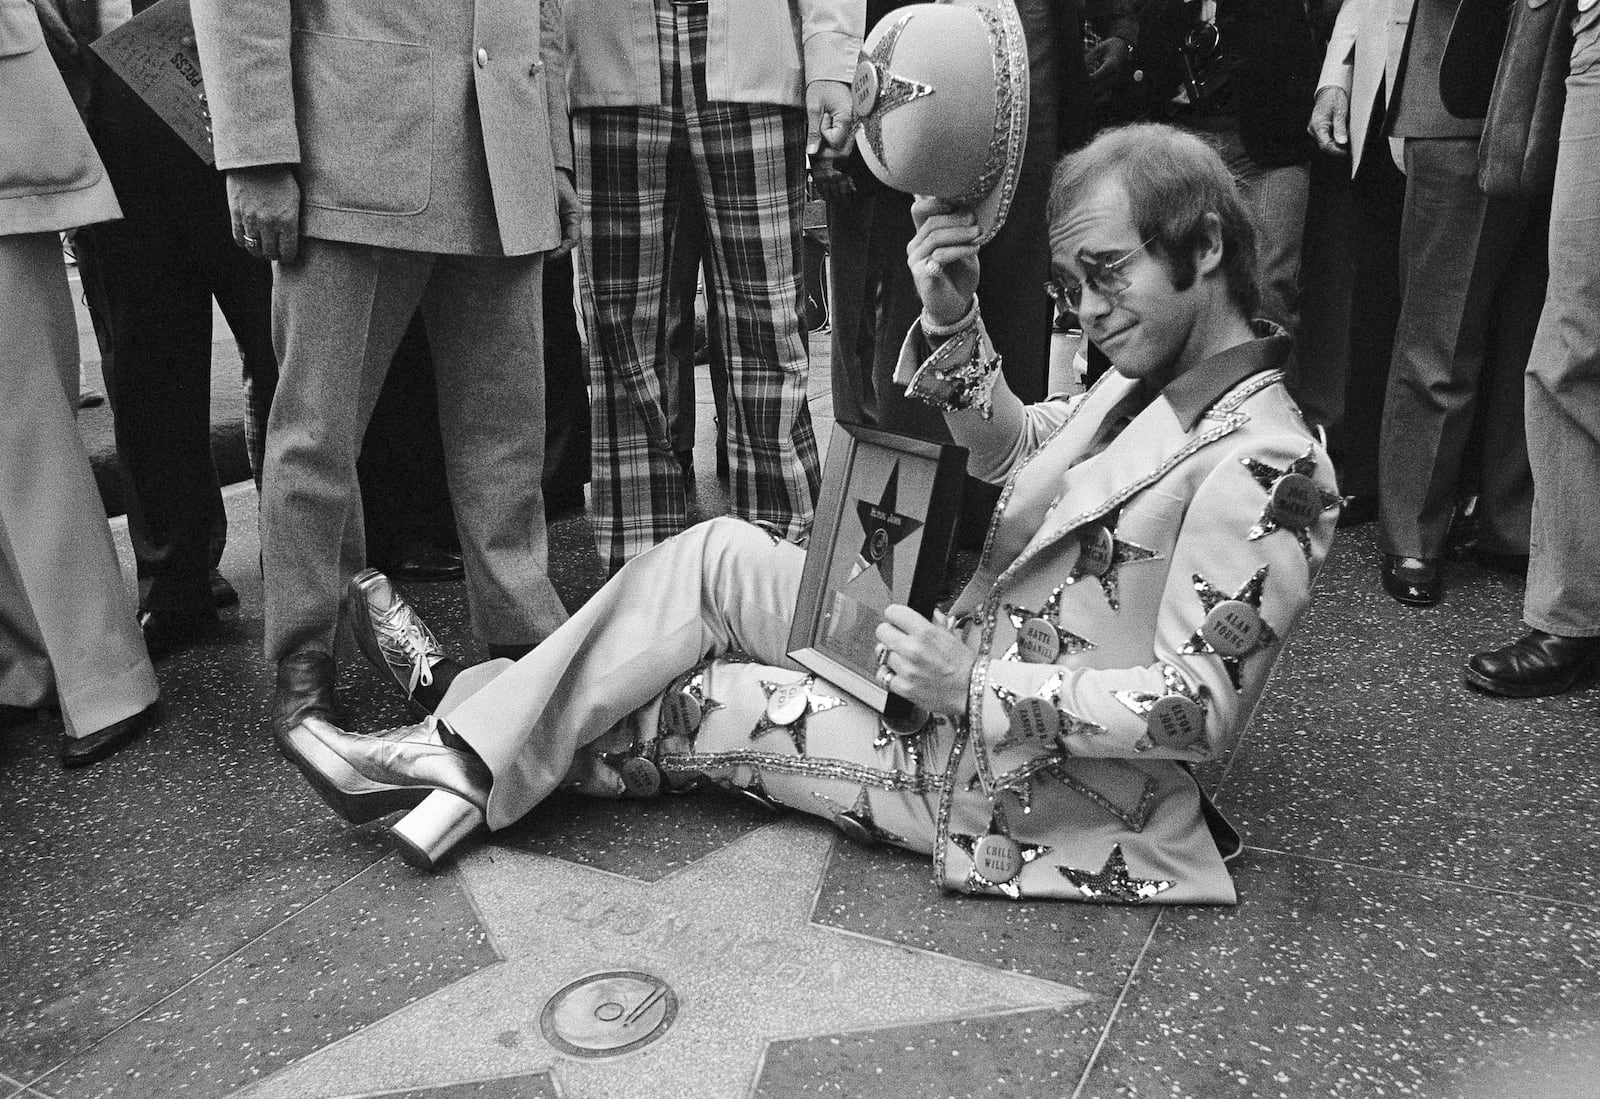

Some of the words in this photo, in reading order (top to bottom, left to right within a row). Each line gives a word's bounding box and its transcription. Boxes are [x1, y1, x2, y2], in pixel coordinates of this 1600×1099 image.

[170, 52, 202, 88] PRESS
[1214, 621, 1241, 648] YOUNG
[1225, 612, 1249, 633] ALAN
[1160, 712, 1177, 736] JOHN
[1171, 704, 1191, 733] ELTON
[986, 845, 1012, 859] CHILL
[985, 858, 1011, 872] WILLS
